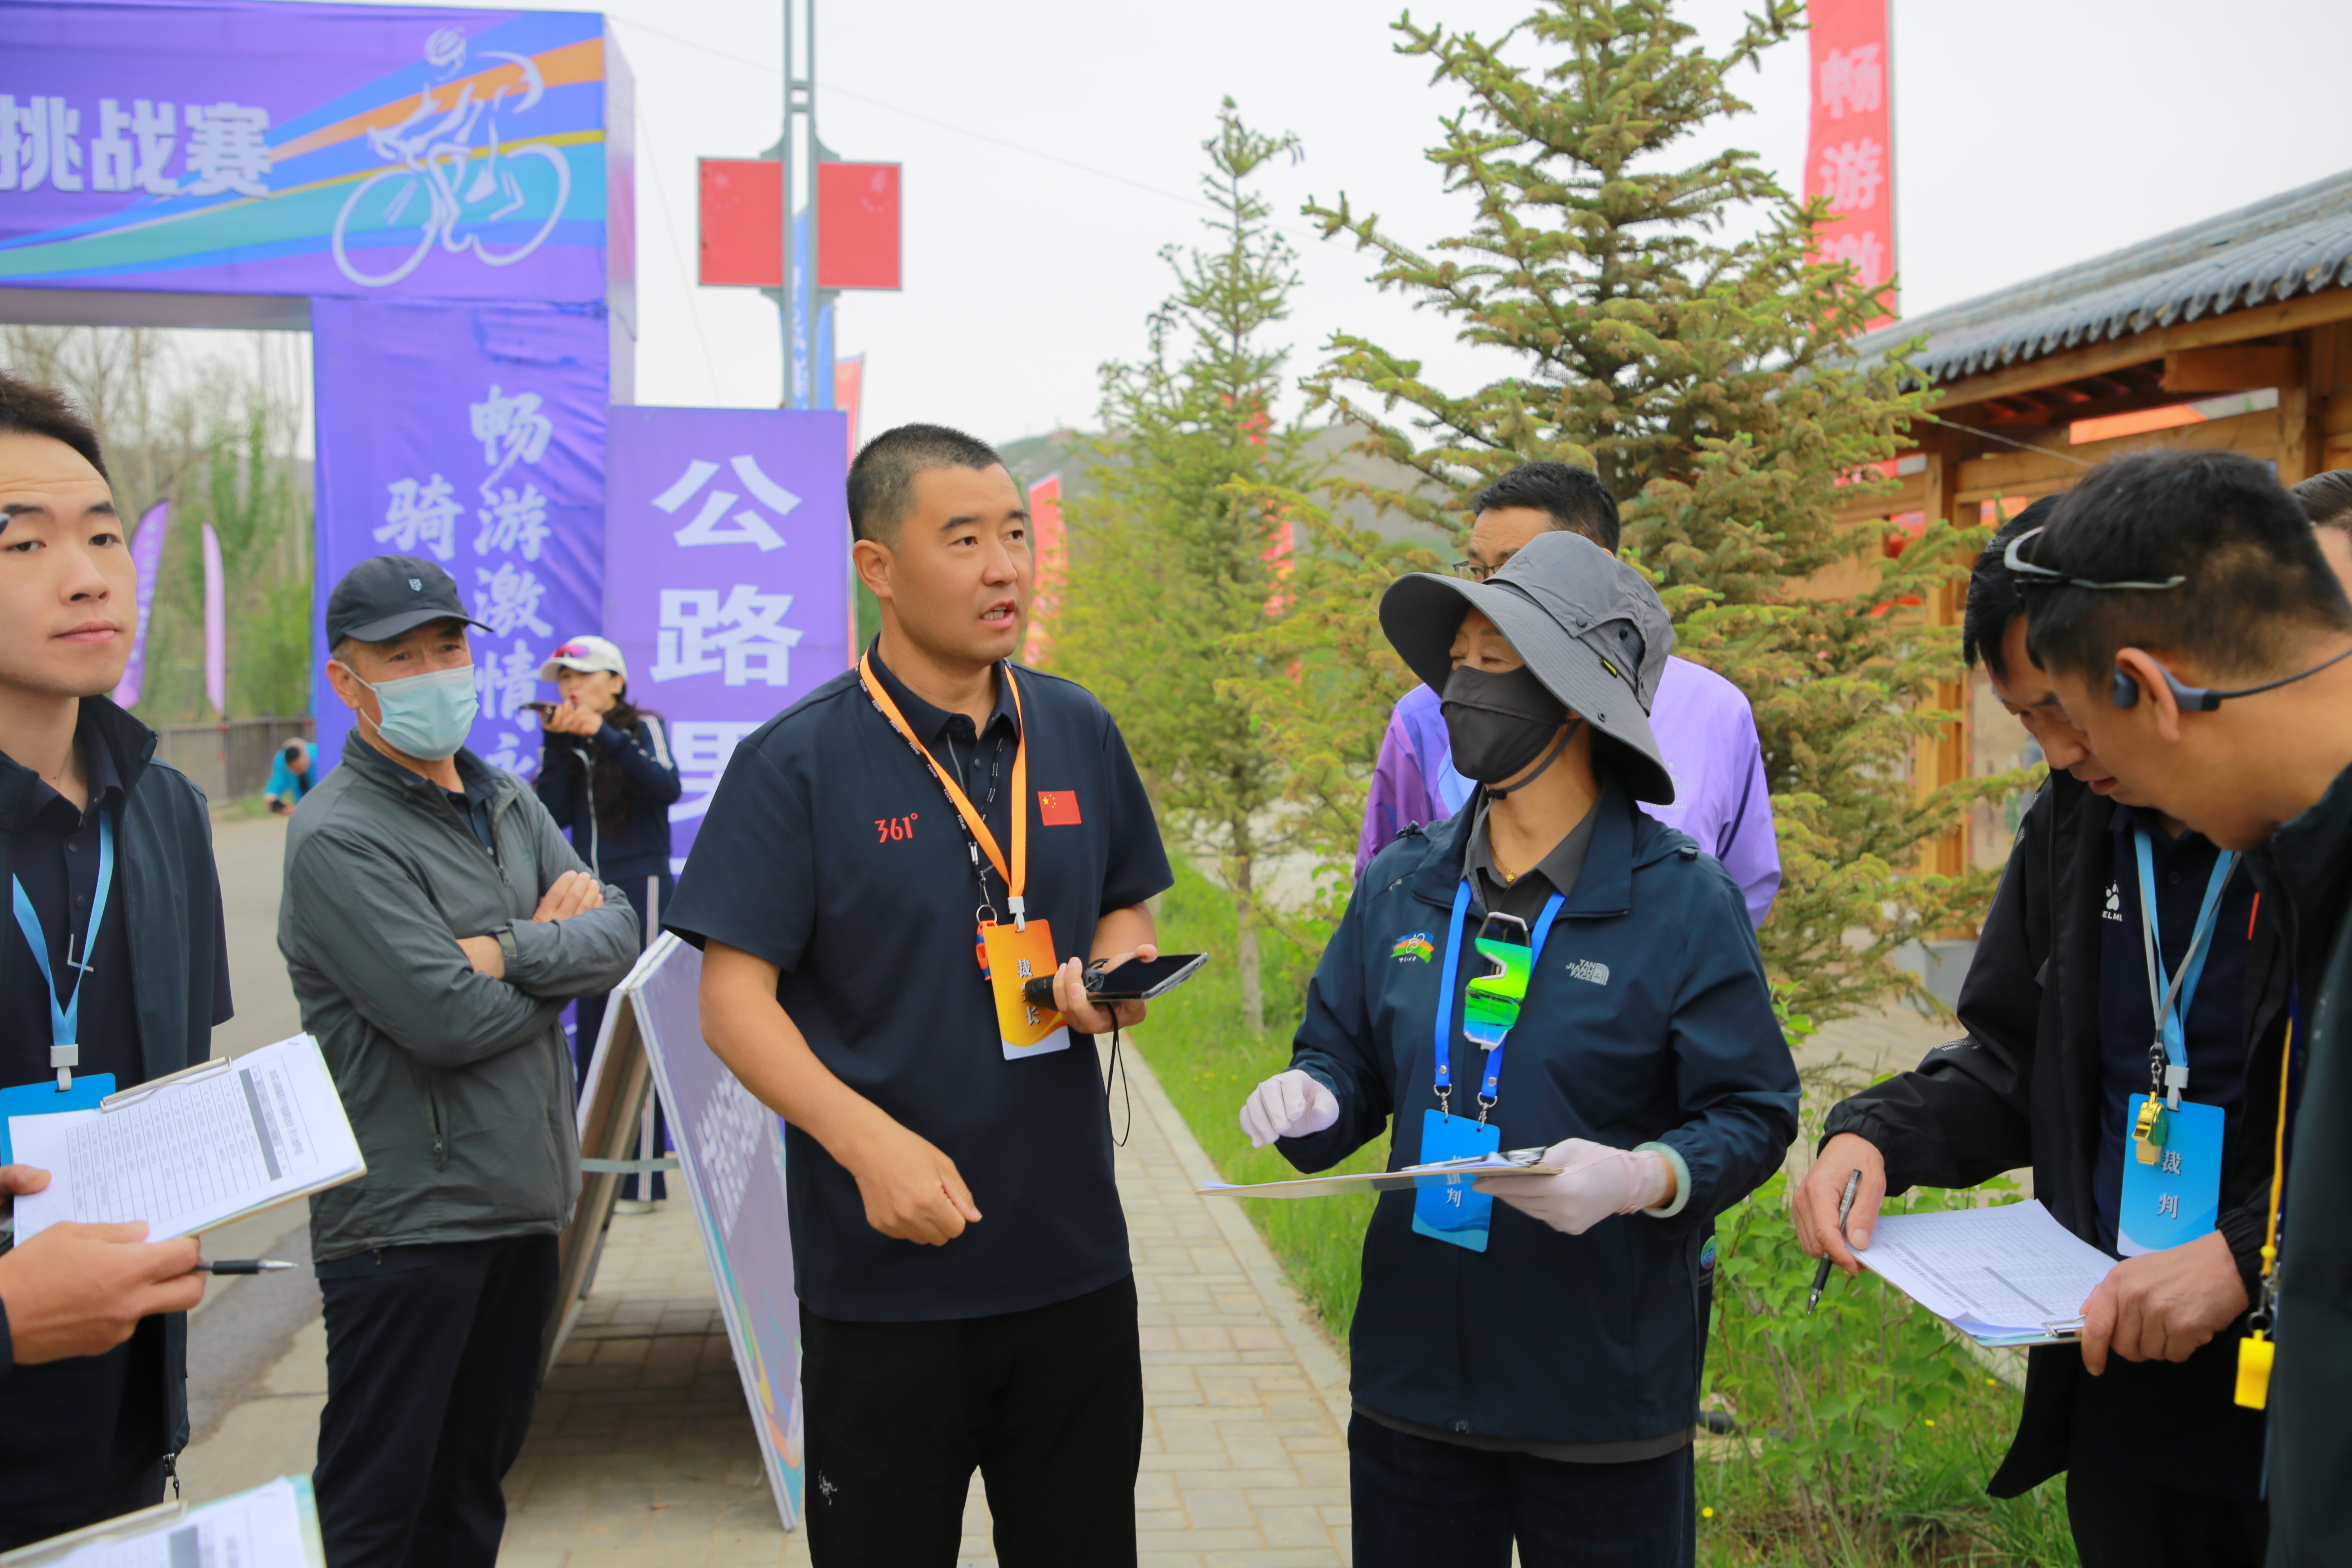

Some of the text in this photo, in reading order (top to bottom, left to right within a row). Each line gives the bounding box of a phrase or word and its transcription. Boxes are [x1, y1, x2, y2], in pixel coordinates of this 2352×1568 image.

[0, 94, 272, 199] 挑战赛
[372, 473, 465, 580] 骑
[649, 455, 805, 875] 公路
[2102, 911, 2123, 922] ELME
[1570, 970, 1592, 981] FACE
[1579, 959, 1596, 968] TAN
[1446, 1155, 1462, 1208] 判
[2156, 1149, 2182, 1219] 裁判
